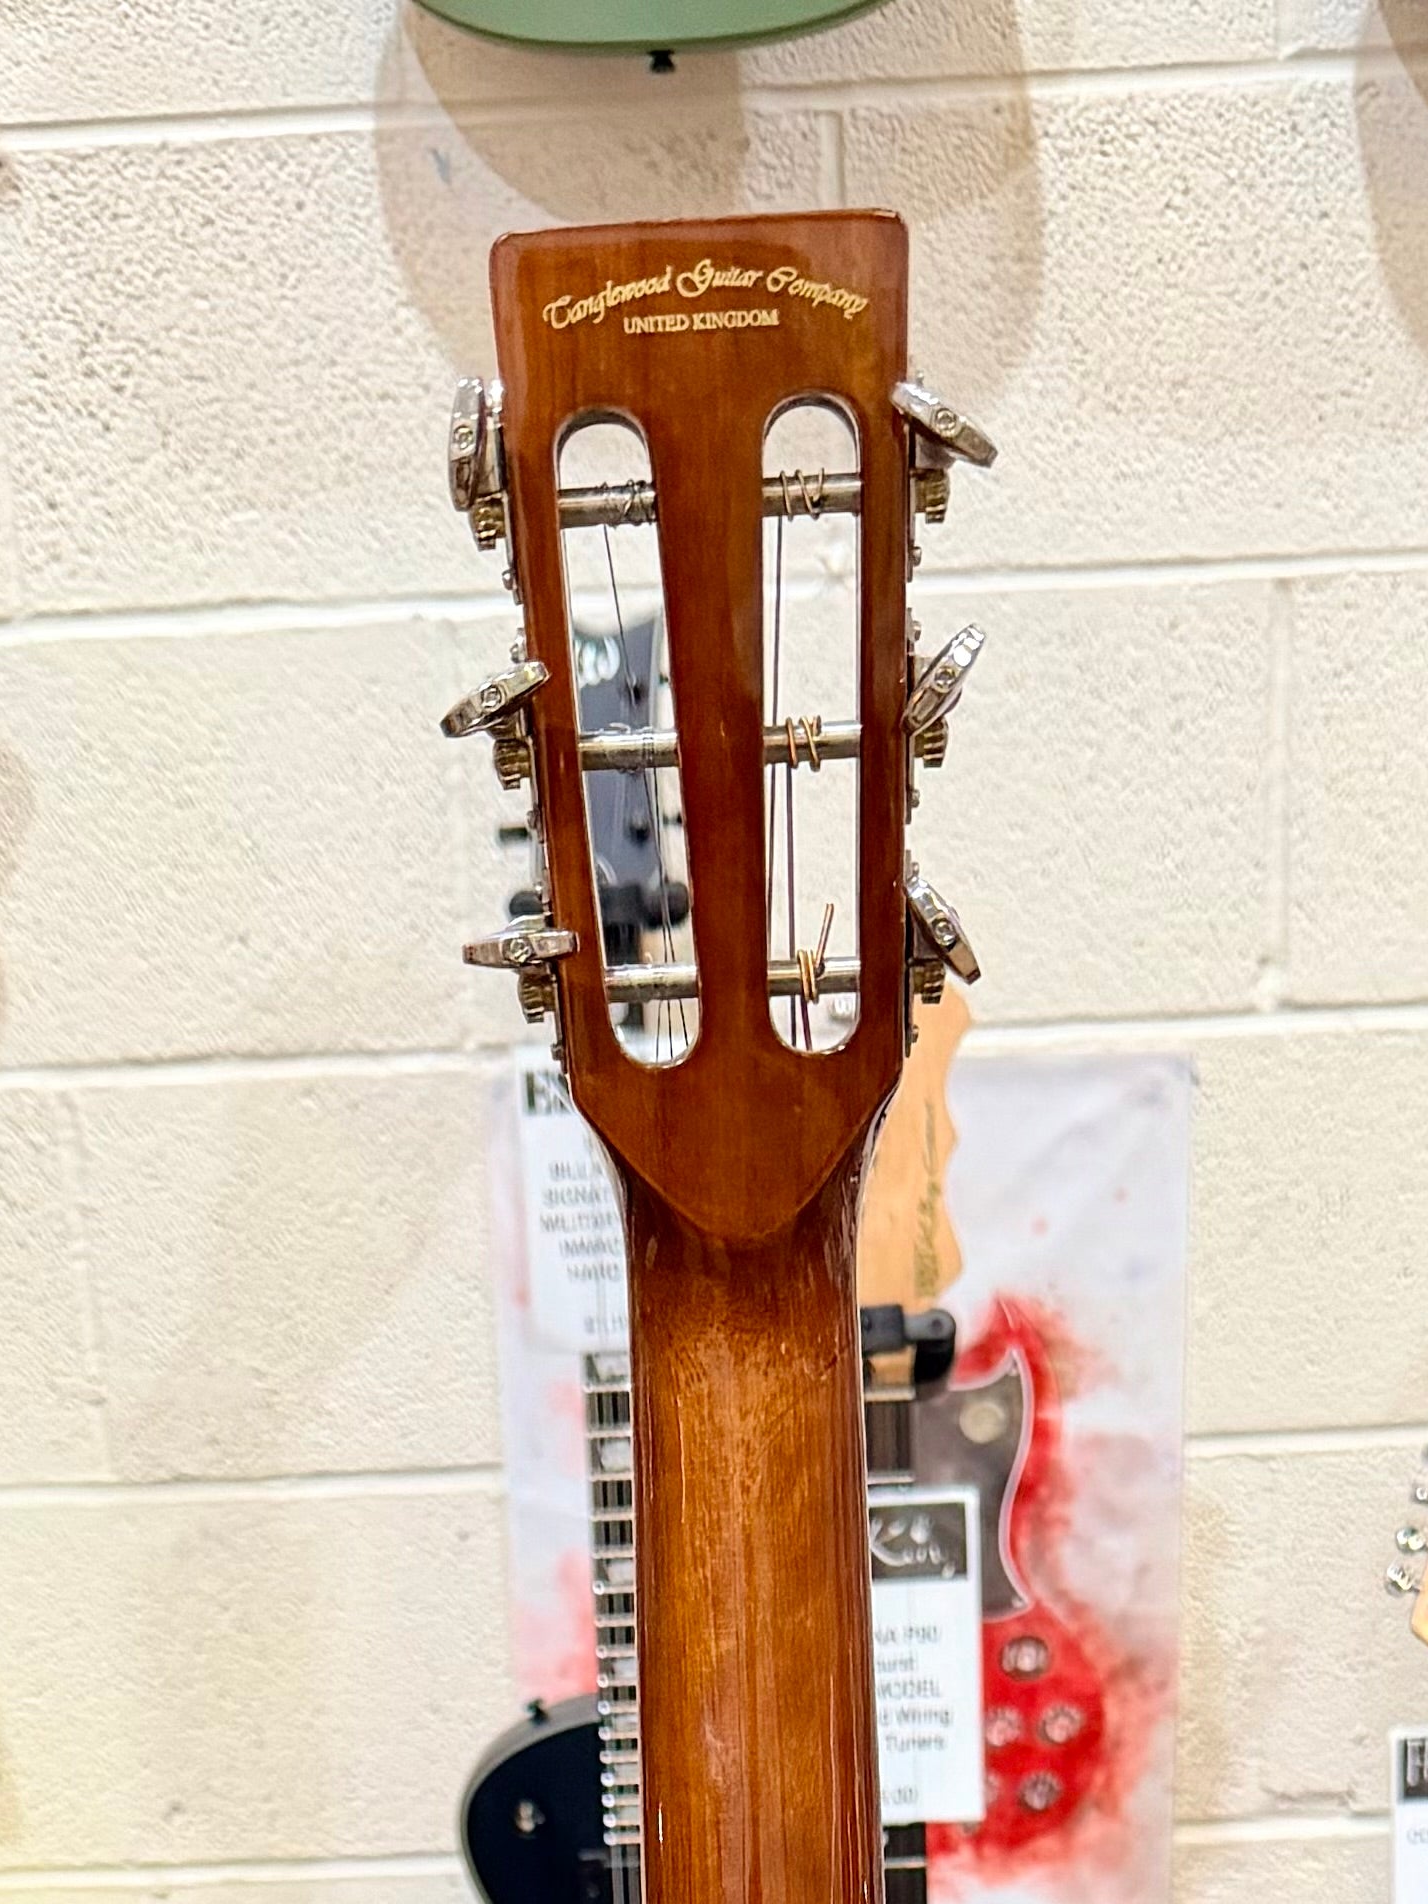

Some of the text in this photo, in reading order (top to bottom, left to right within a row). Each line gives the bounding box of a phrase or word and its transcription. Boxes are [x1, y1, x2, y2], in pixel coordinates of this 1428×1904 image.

[542, 258, 869, 330] Tanglewood Guitar Company
[623, 308, 780, 335] UNITED KINGDOM
